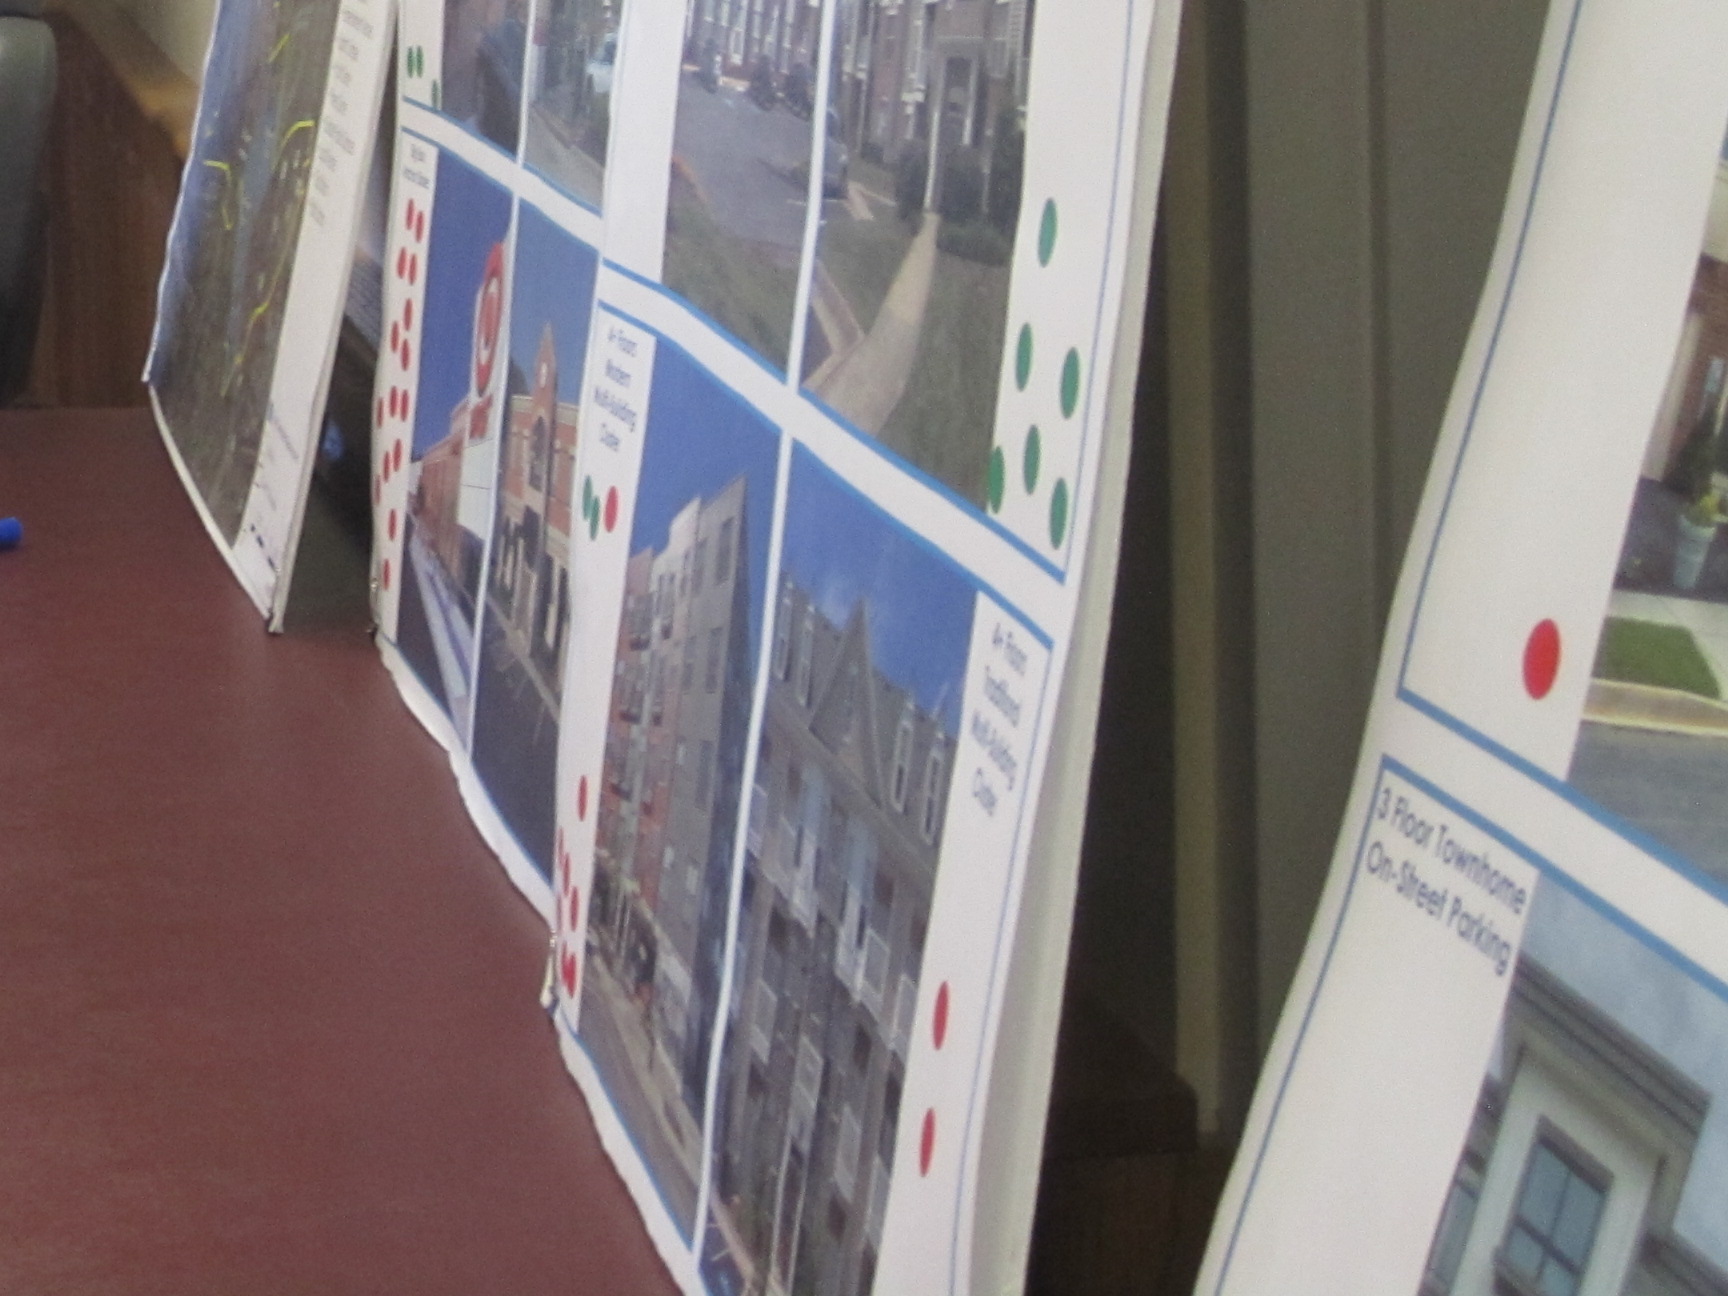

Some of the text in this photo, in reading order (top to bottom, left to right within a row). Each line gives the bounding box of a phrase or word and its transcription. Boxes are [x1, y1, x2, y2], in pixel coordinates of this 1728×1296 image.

[1366, 840, 1512, 977] On-Street Parking
[1377, 786, 1527, 915] 3 Floor Townhome
